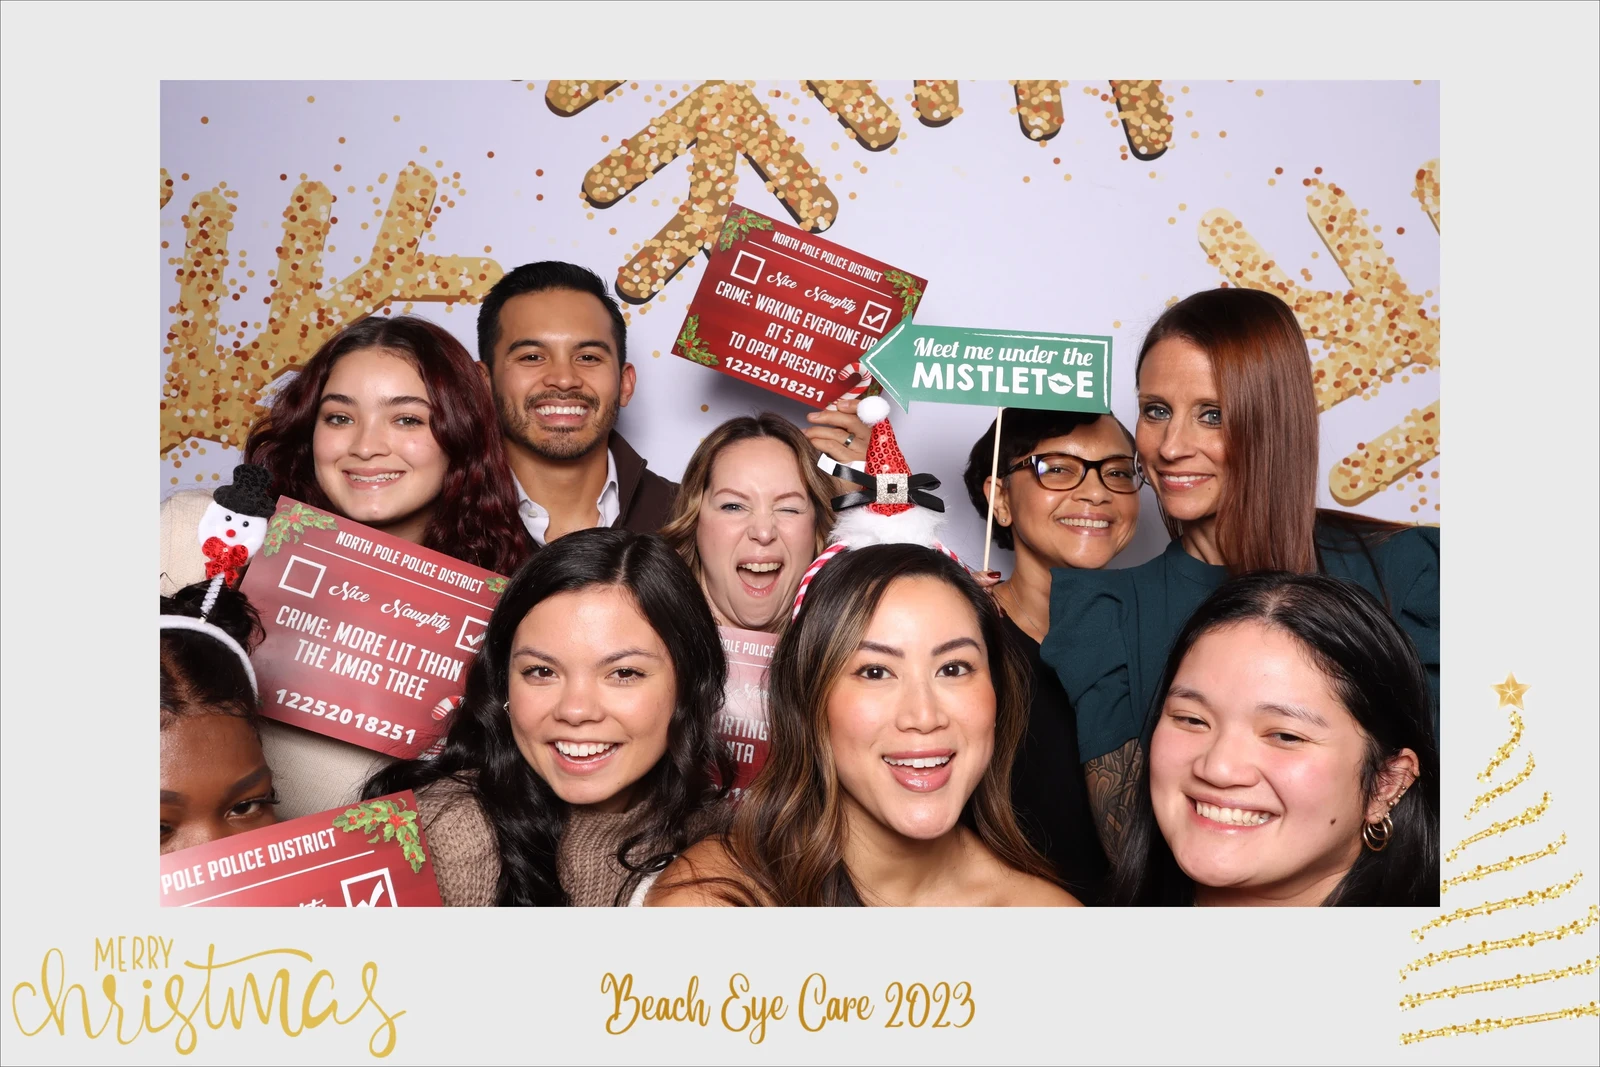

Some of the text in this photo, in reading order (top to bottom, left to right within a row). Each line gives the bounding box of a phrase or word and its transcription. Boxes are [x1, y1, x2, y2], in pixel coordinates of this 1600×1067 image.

[772, 231, 883, 283] NORTH POLE POLICE DISTRICT
[715, 281, 878, 350] CRIME: WAKING EVERYONE UP
[767, 272, 856, 314] Nice Naughty
[729, 331, 836, 383] TO OPEN PRESENTS
[765, 322, 814, 352] AT 5 AM
[914, 337, 1093, 366] Meet me under the
[726, 357, 824, 402] 12252018251
[912, 362, 1093, 398] MISTLETE
[336, 531, 484, 593] NORTH POLE POLICE DISTRICT
[329, 583, 450, 634] Nice Naughty
[276, 606, 464, 682] CRIME: MORE LIT THAN
[295, 639, 429, 700] THE XMAS TREE
[724, 639, 741, 653] OLE
[276, 689, 416, 744] 12252018251
[718, 714, 769, 741] IRTING
[161, 828, 336, 895] POLE POLICE DISTRICT
